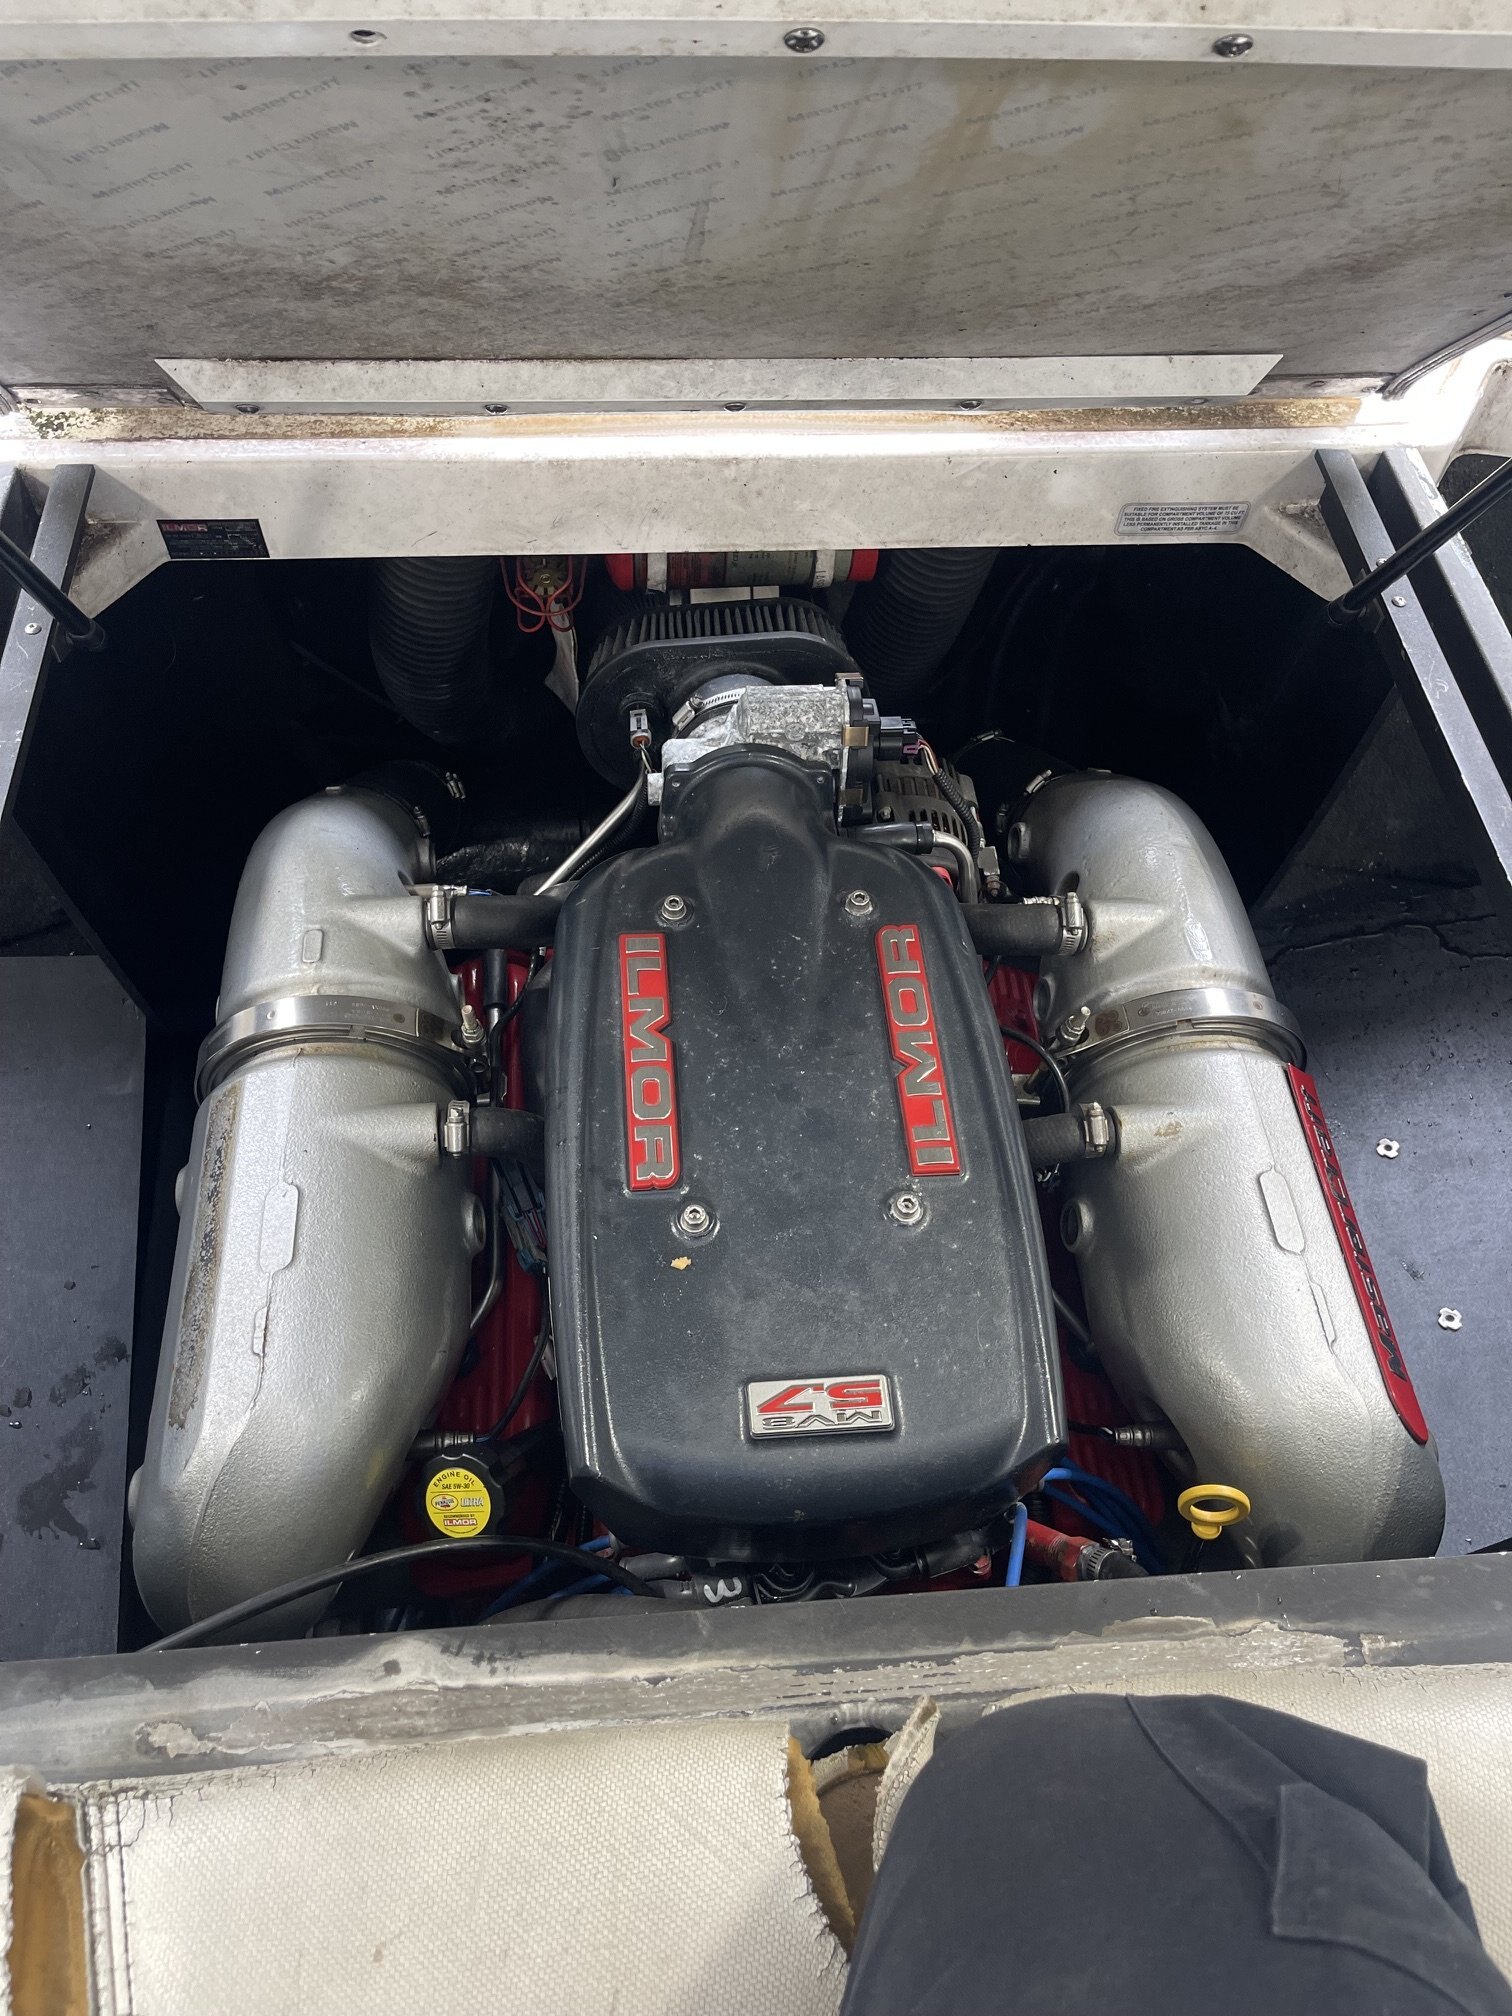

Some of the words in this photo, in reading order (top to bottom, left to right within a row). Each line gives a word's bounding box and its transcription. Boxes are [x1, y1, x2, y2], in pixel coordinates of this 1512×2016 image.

[625, 936, 675, 1181] ILMOR
[881, 928, 955, 1166] ILMOR
[756, 1380, 883, 1415] 5.7
[761, 1409, 883, 1430] MV8
[433, 1471, 461, 1487] ENGINE
[464, 1474, 475, 1486] OIL
[444, 1518, 478, 1526] ILMOR
